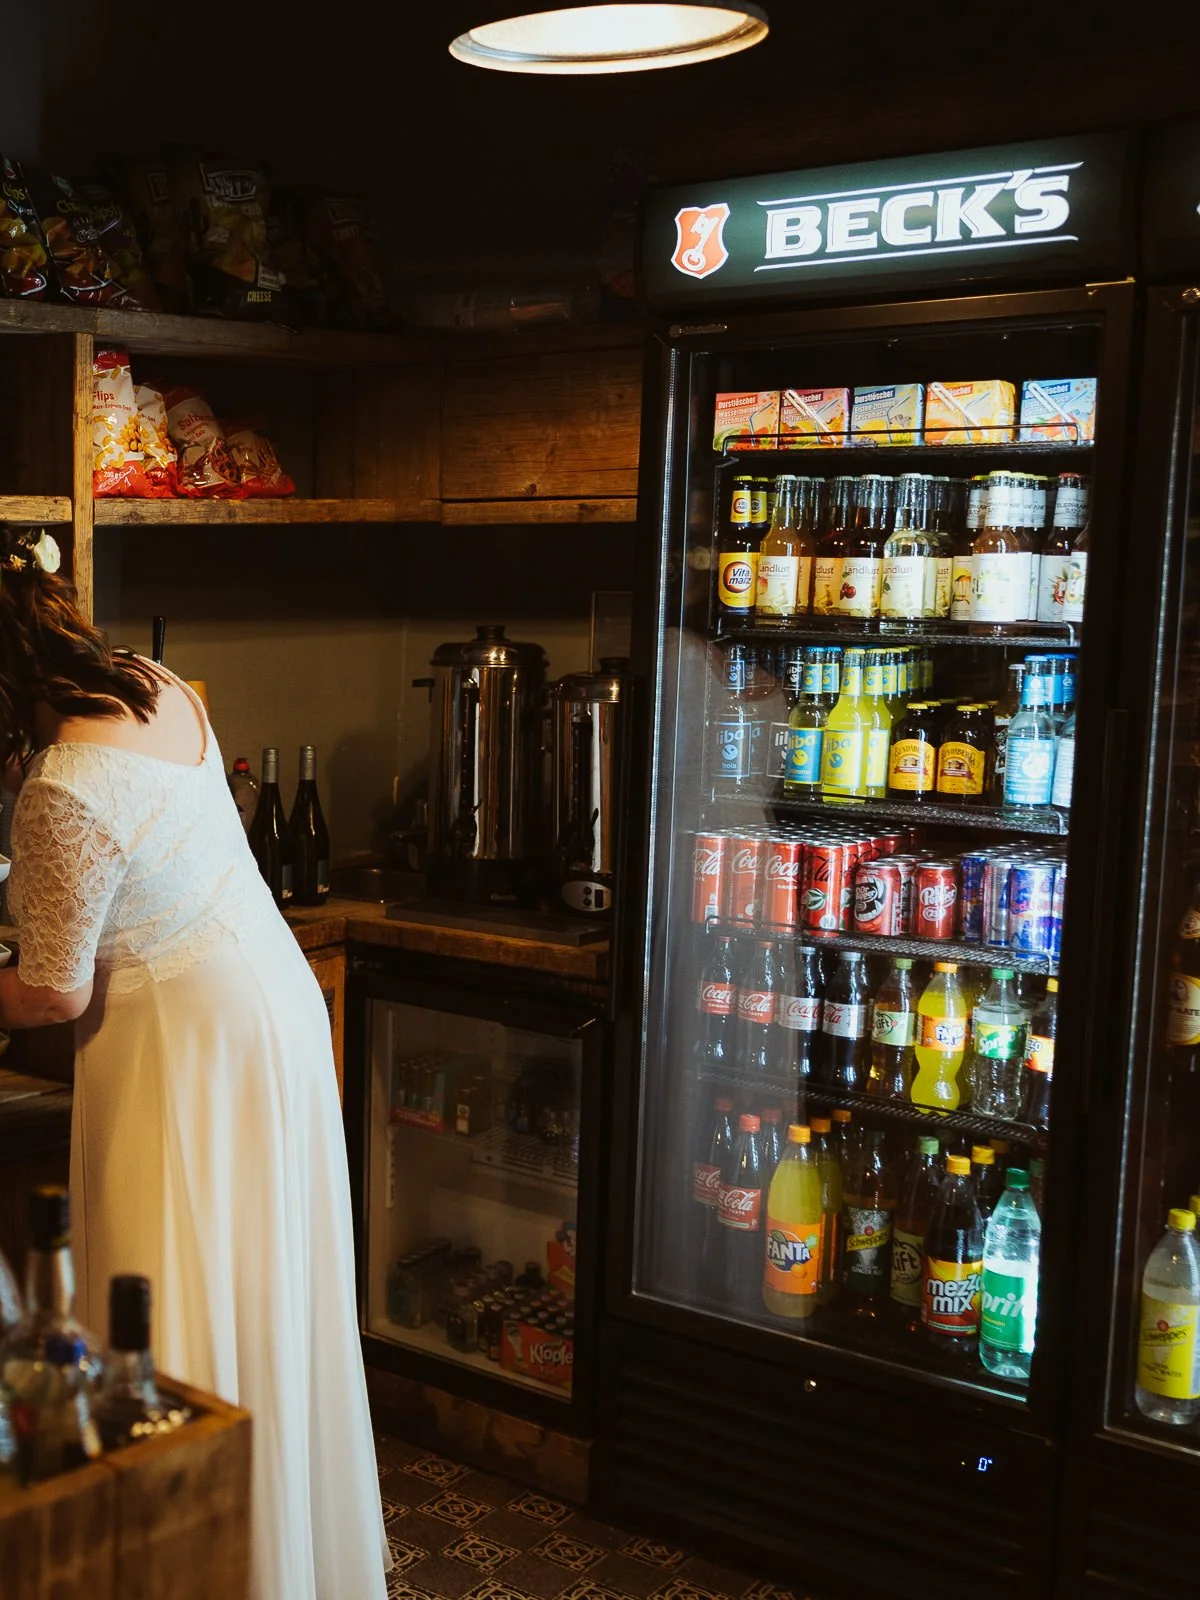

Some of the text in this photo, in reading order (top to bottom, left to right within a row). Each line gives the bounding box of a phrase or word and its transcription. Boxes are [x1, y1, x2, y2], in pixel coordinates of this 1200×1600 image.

[764, 169, 1070, 260] BECK'S
[247, 290, 273, 303] CHEESE
[718, 398, 756, 409] Durstlöscher
[855, 390, 894, 404] Durstlöscher
[732, 568, 750, 578] Vita
[767, 1236, 811, 1263] FANTA
[933, 1291, 973, 1313] mix
